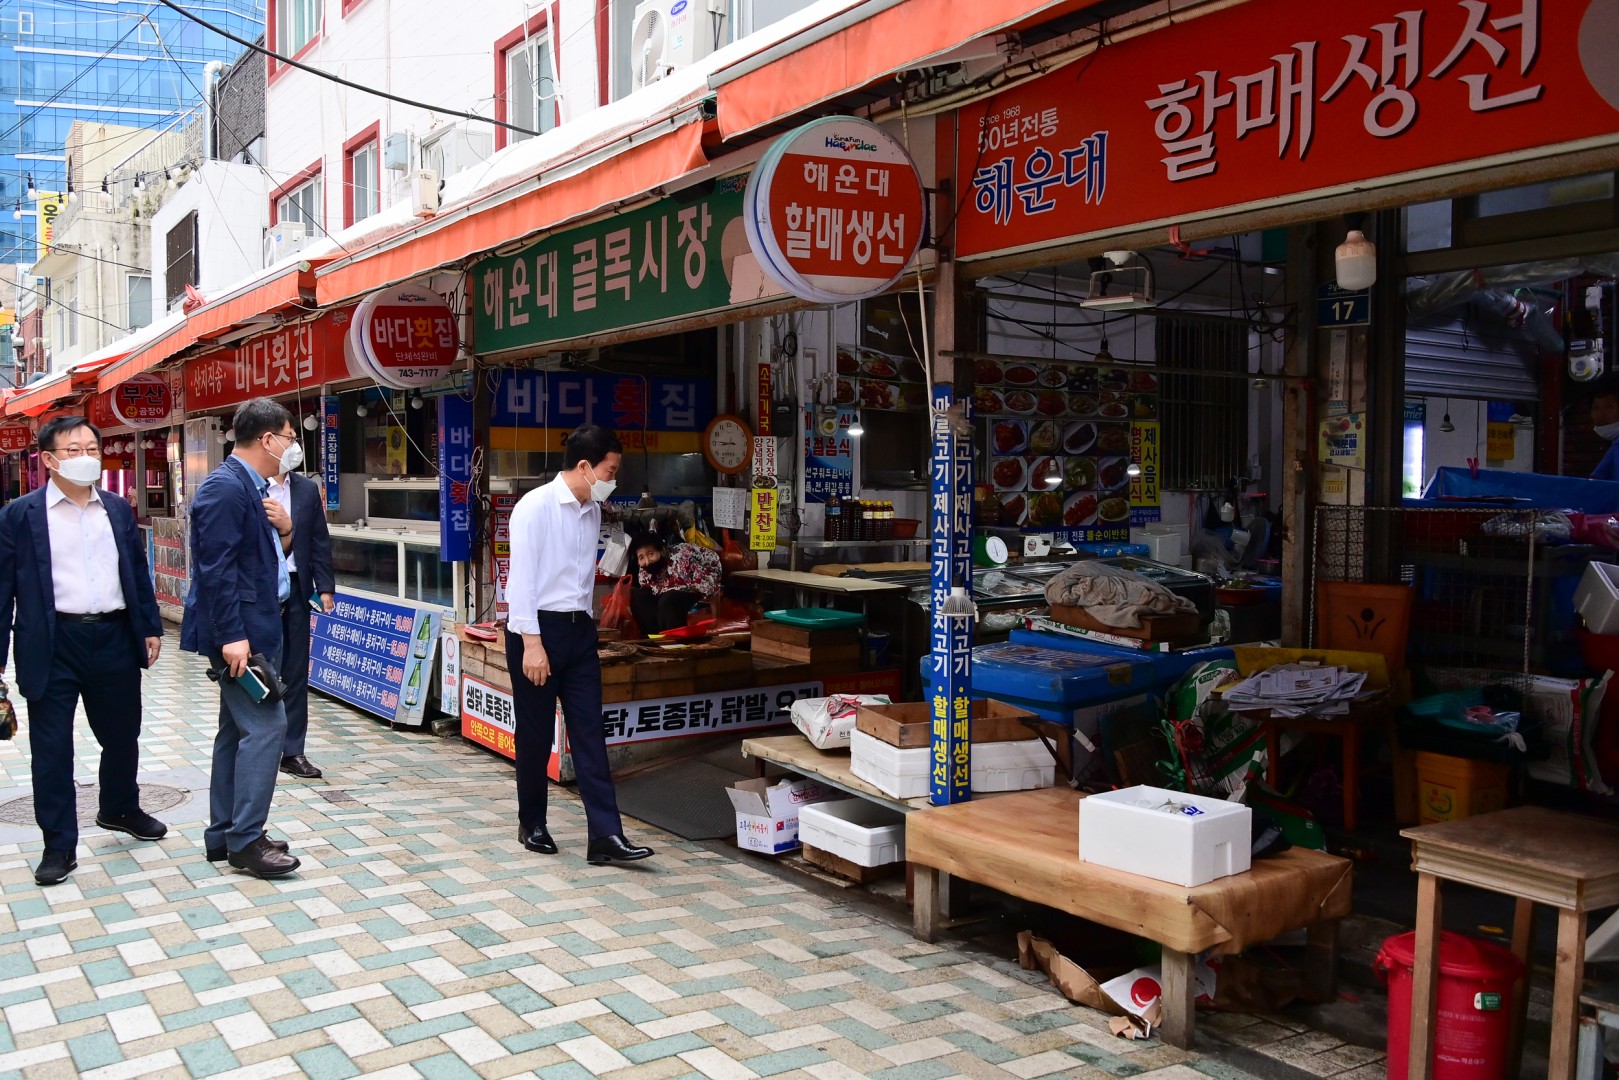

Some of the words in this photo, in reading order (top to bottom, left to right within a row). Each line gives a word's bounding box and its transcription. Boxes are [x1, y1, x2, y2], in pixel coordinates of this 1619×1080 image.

[1145, 0, 1544, 182] 할매생선
[977, 107, 1059, 154] 50년전통
[979, 114, 1000, 128] Snce
[1003, 105, 1021, 120] 1968
[824, 137, 878, 152] Haeundae
[803, 161, 890, 198] 해운대
[973, 130, 1109, 226] 해운대
[785, 201, 905, 266] 할매생선
[482, 248, 558, 332] 해운대
[572, 201, 712, 314] 골목시장
[373, 317, 454, 349] 바다횟집
[1331, 300, 1356, 322] 17
[234, 322, 313, 393] 바다횟집
[395, 351, 438, 362] 단체석완비
[398, 368, 439, 378] 743-7177
[122, 385, 166, 405] 부산
[505, 374, 697, 428] 바다횟집
[759, 366, 770, 433] 소고기국
[1403, 409, 1423, 419] rrier
[327, 432, 338, 484] 포장됩니다
[449, 425, 472, 532] 바다횟집
[754, 437, 764, 477] 양념게장
[766, 437, 776, 477] 간장게장
[1144, 426, 1158, 503] 제사음식
[756, 491, 773, 533] 반찬
[470, 719, 496, 744] 안쪽으로
[933, 694, 948, 787] 할매생선
[953, 695, 970, 788] 할매생선
